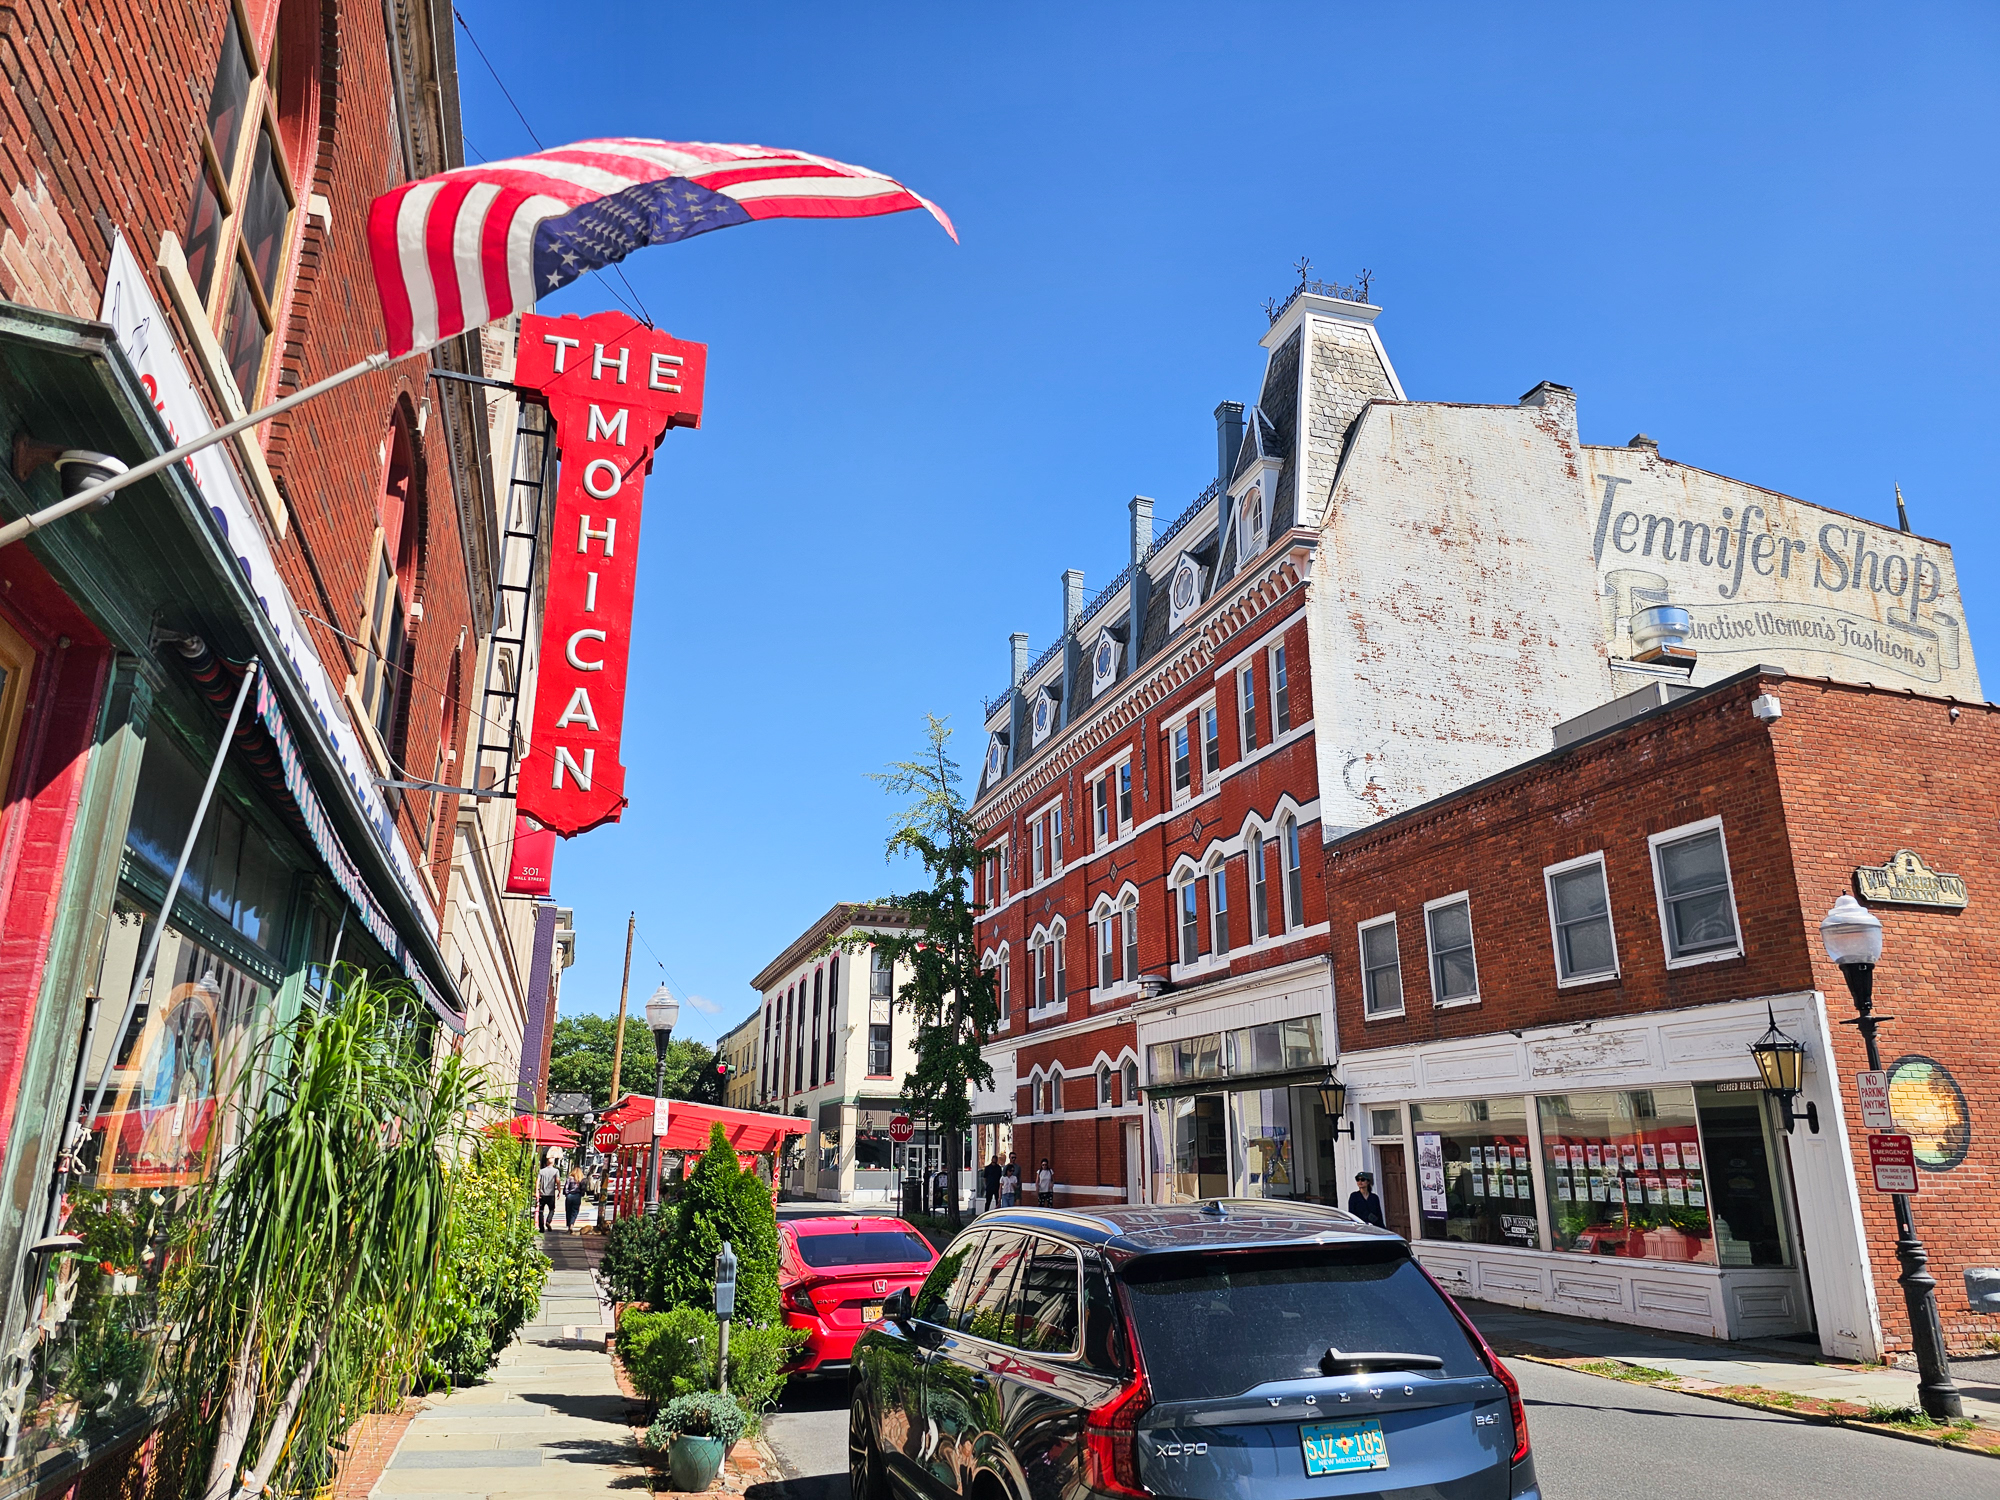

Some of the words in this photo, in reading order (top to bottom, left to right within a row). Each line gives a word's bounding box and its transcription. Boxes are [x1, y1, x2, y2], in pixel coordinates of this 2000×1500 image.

[543, 334, 684, 394] THE
[1593, 473, 1806, 600] Jennifer
[1813, 523, 1941, 625] Shop
[551, 403, 629, 792] MOHICAN
[1754, 610, 1836, 642] Women's
[522, 866, 539, 876] 301
[1895, 875, 1963, 898] MORRISON
[1892, 888, 1939, 901] REALTY
[1716, 1083, 1738, 1092] LICENSED
[1740, 1081, 1752, 1090] REAL
[1753, 1081, 1767, 1090] ESTA
[1865, 1074, 1878, 1086] NO
[1860, 1087, 1886, 1098] PARKING
[1863, 1099, 1888, 1110] ANYTIME
[891, 1124, 912, 1134] STOP
[595, 1133, 620, 1145] STOP
[1267, 1384, 1414, 1408] VOLVO
[1354, 1429, 1384, 1456] 185
[1156, 1443, 1208, 1457] XC90
[1336, 1456, 1361, 1464] MEXICO
[1361, 1455, 1376, 1463] USA
